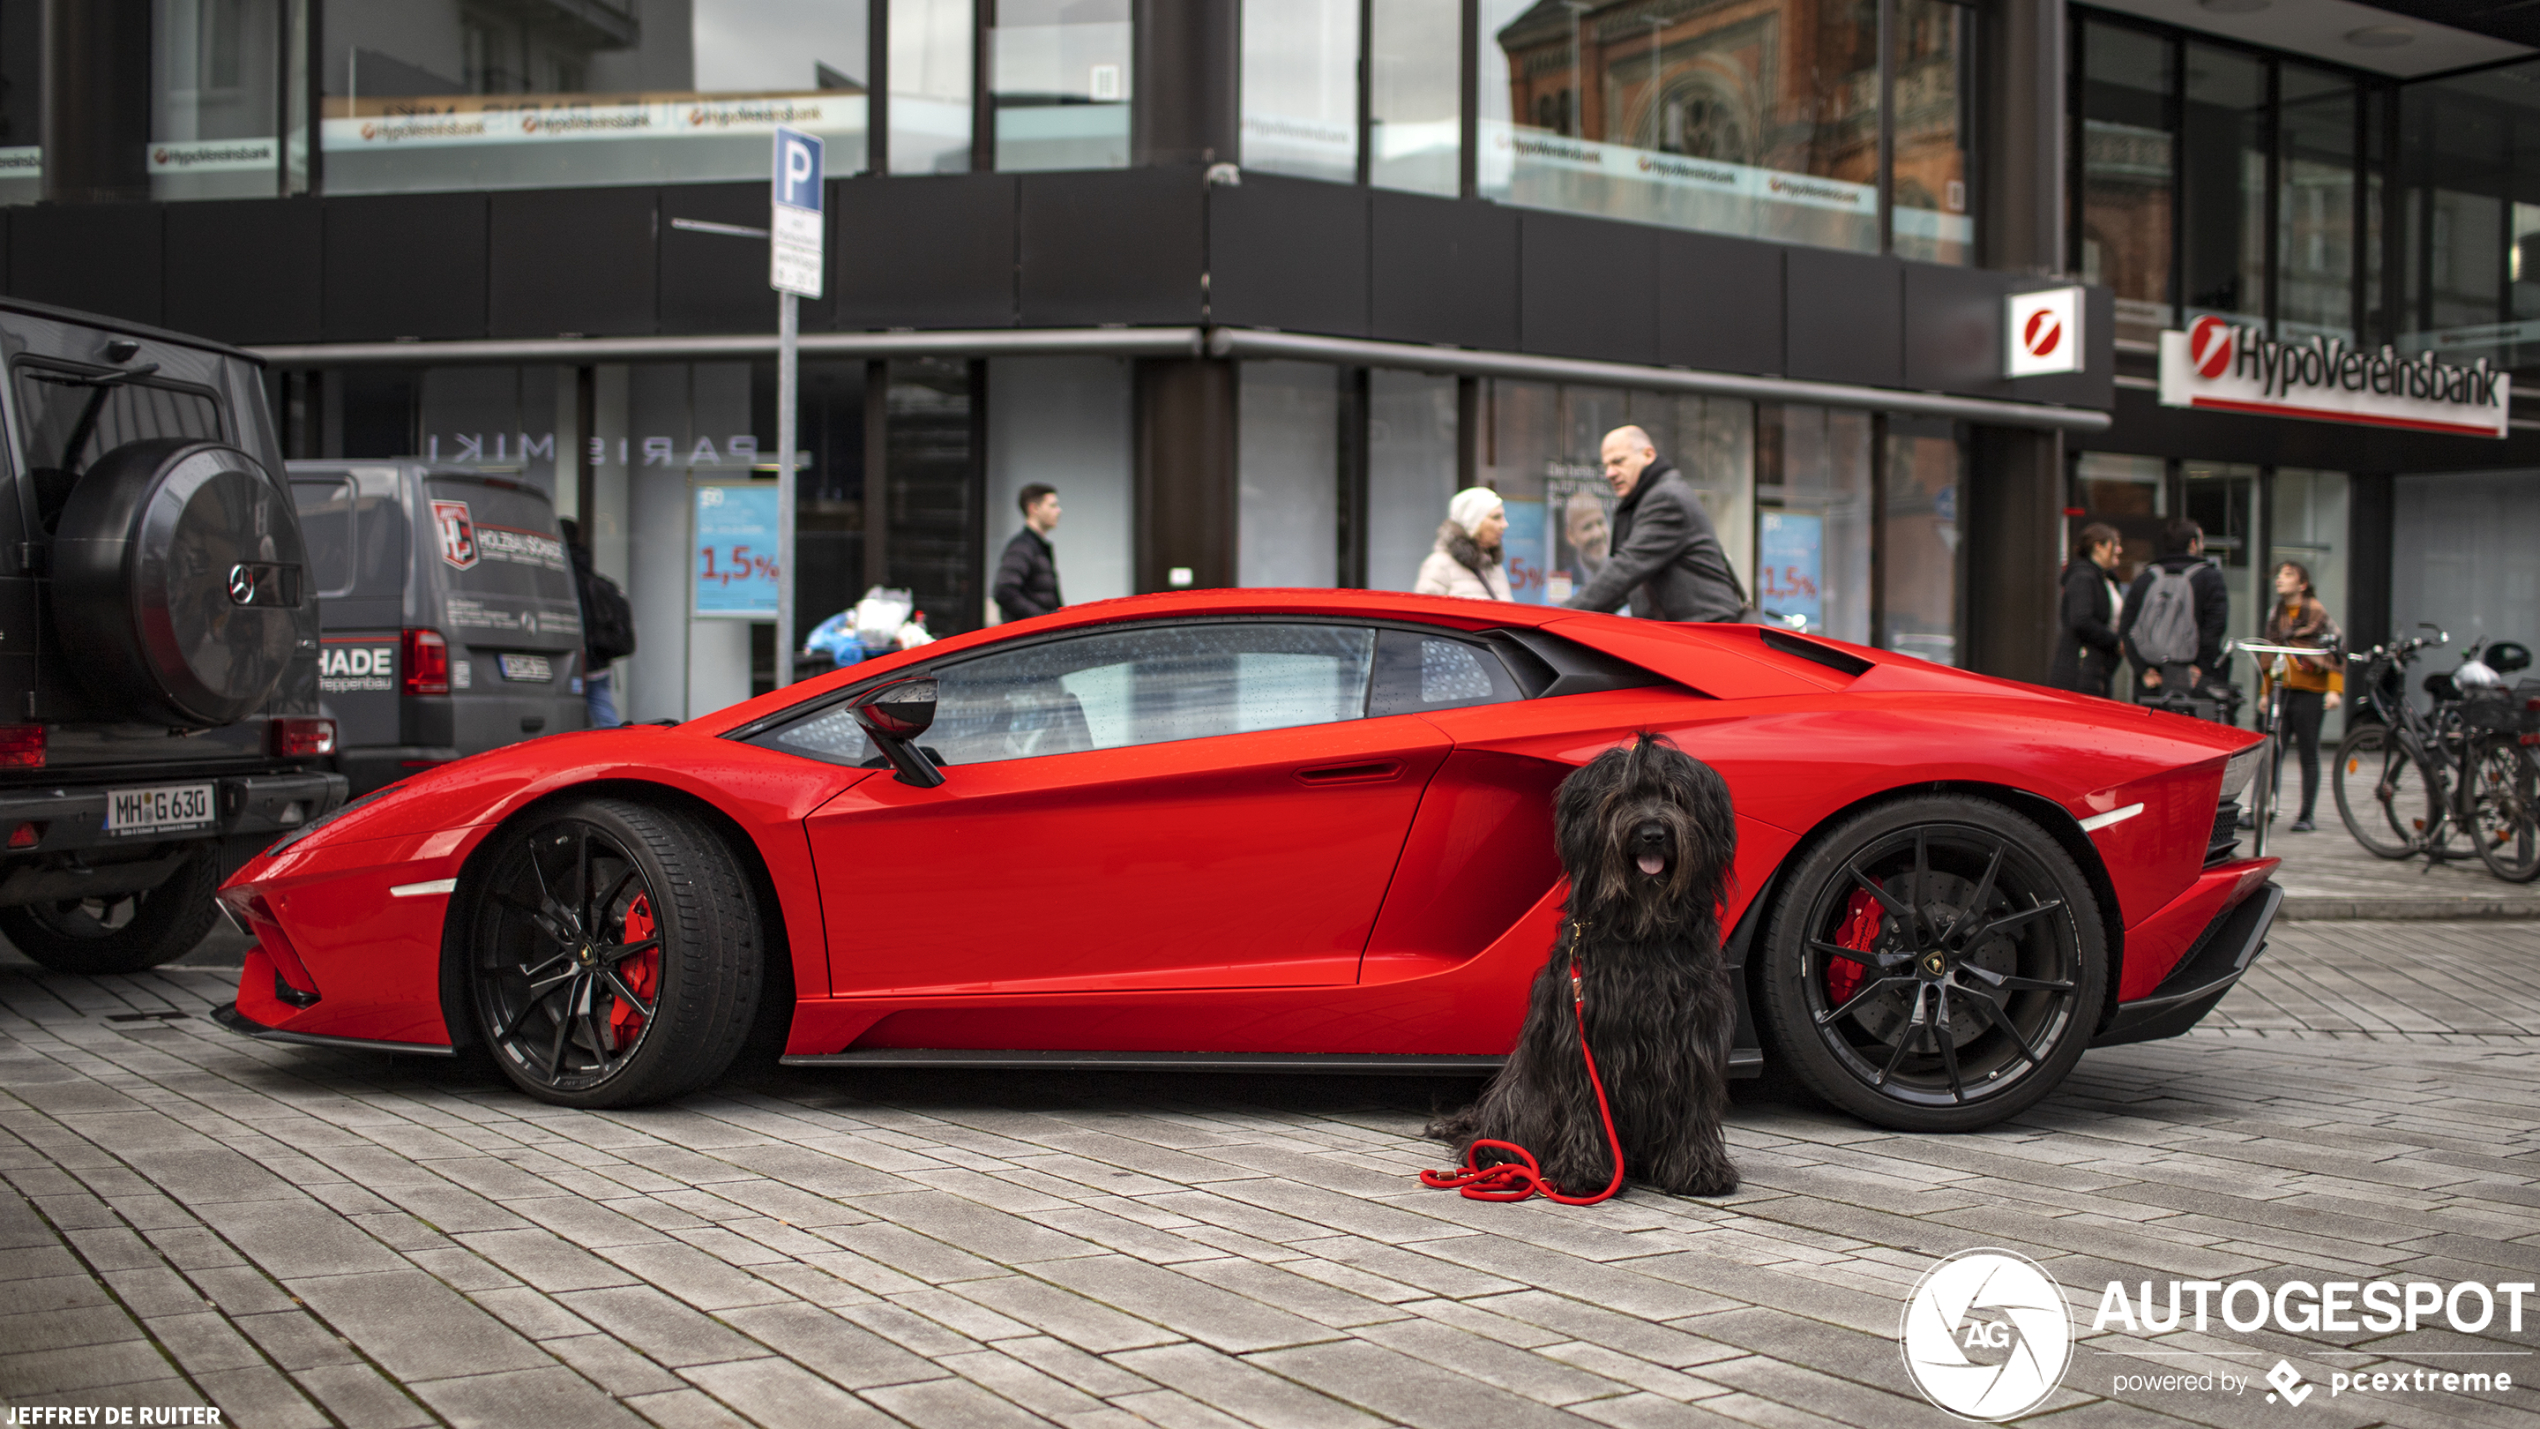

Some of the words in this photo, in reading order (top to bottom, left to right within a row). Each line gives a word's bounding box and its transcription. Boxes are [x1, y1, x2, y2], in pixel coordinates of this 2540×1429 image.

[538, 113, 651, 134] HypoVereinsbank
[704, 105, 822, 126] HypoVereinsbank
[377, 122, 486, 141] HypoVereinsbank
[168, 146, 272, 166] HypoVereinsbank
[785, 140, 813, 202] P
[1651, 159, 1737, 185] HypoVereinsbank
[2229, 325, 2500, 407] HypoVereinsbank
[701, 545, 779, 587] 1,5%
[1763, 565, 1818, 602] 1,5%
[116, 793, 143, 825] MH
[155, 792, 168, 820] G
[171, 789, 206, 819] 630
